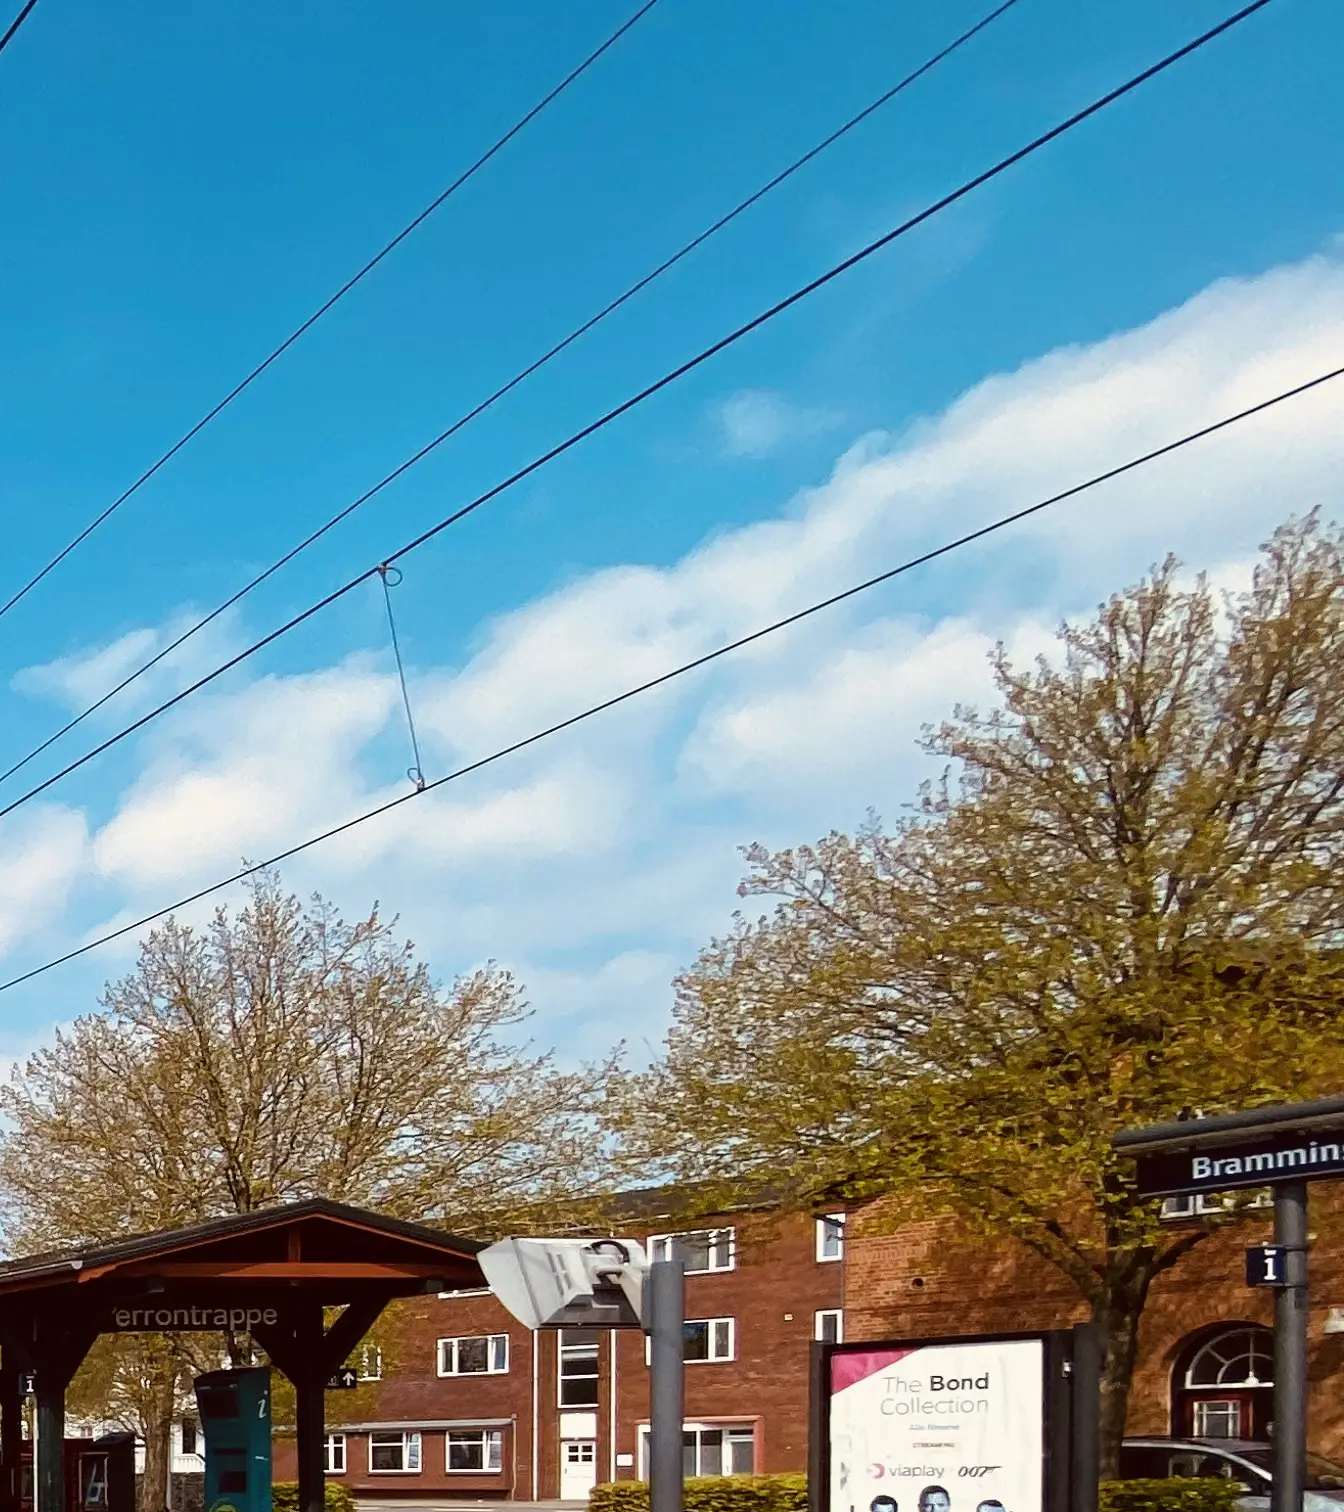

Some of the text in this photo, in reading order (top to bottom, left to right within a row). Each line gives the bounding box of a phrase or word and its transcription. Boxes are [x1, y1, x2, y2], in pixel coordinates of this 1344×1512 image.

[1191, 1141, 1344, 1179] Brammin
[1263, 1257, 1277, 1281] 1
[112, 1305, 278, 1330] errontrappe
[26, 1379, 34, 1393] 1
[882, 1372, 990, 1394] The Bond
[880, 1396, 989, 1416] Collection
[888, 1464, 1001, 1478] viaplay 007
